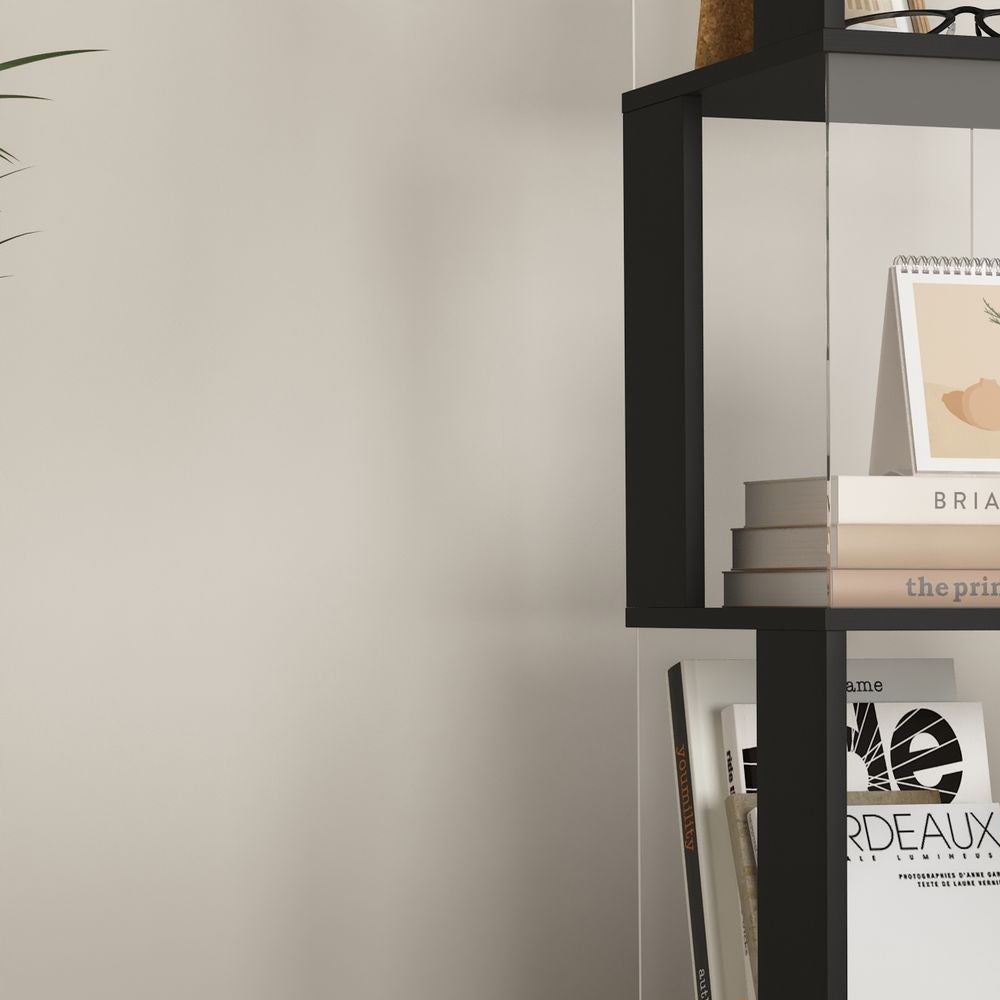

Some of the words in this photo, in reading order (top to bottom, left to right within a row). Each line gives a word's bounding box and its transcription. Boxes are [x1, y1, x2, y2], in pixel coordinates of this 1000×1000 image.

[905, 576, 949, 597] the
[898, 872, 956, 880] PHOTOGRAPHIES
[958, 871, 984, 879] D'ANNE
[917, 880, 939, 888] TEXTE
